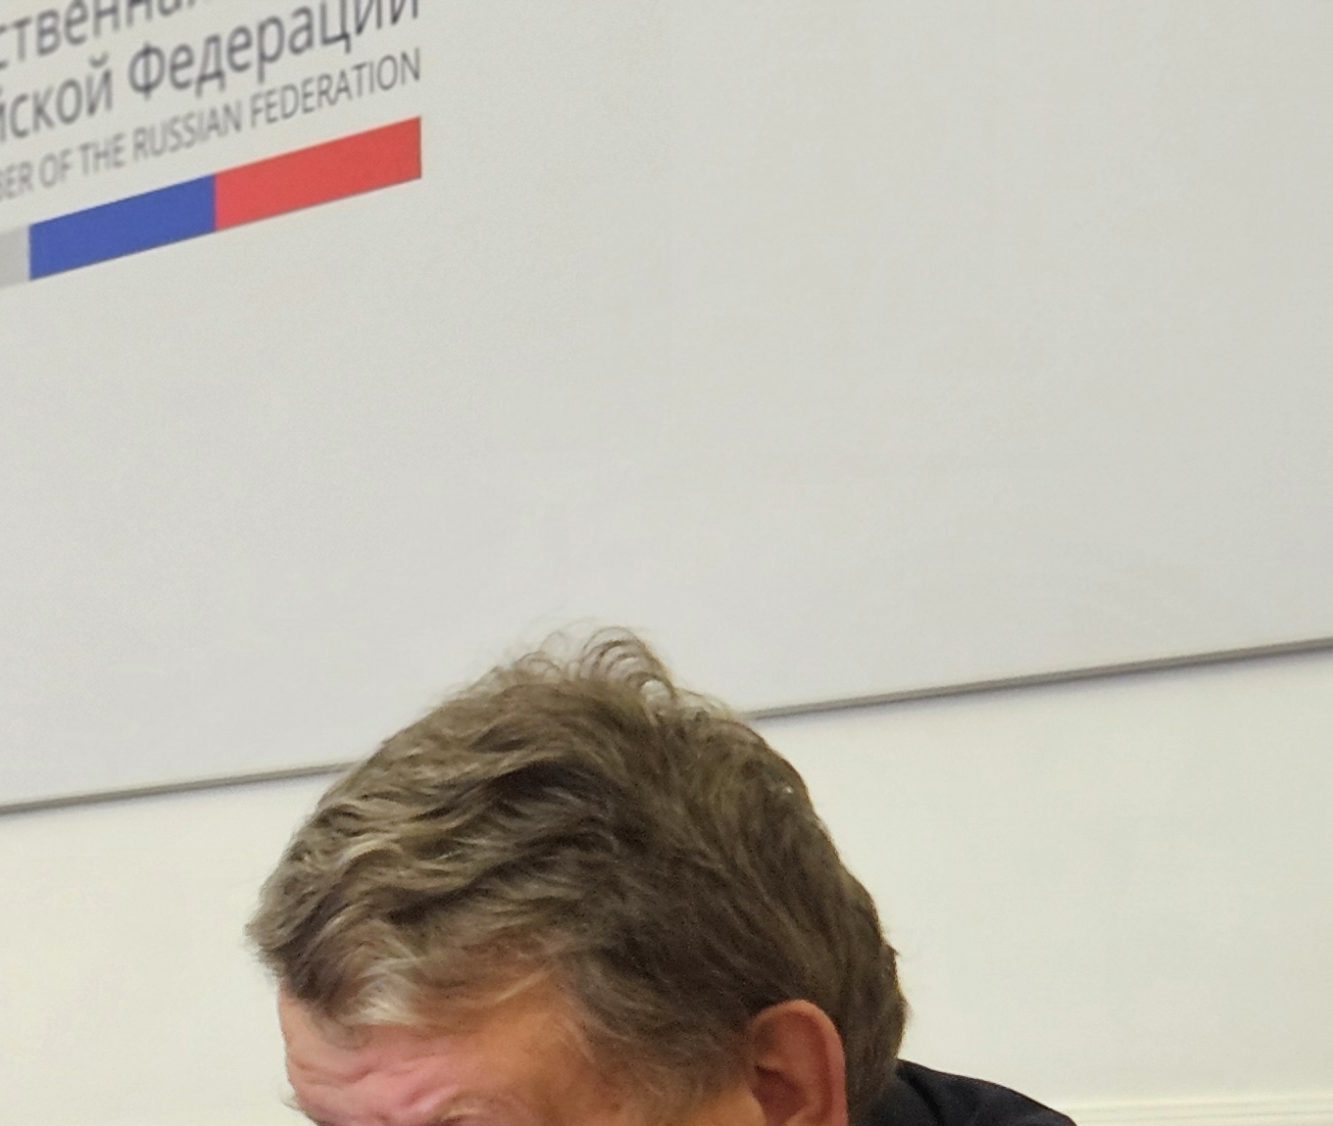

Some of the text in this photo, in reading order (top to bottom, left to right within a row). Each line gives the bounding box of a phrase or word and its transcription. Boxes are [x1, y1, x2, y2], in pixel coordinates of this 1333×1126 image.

[38, 146, 73, 189] OF
[79, 131, 126, 177] THE
[133, 100, 242, 162] RUSSIAN
[249, 47, 421, 130] FEDERATION
